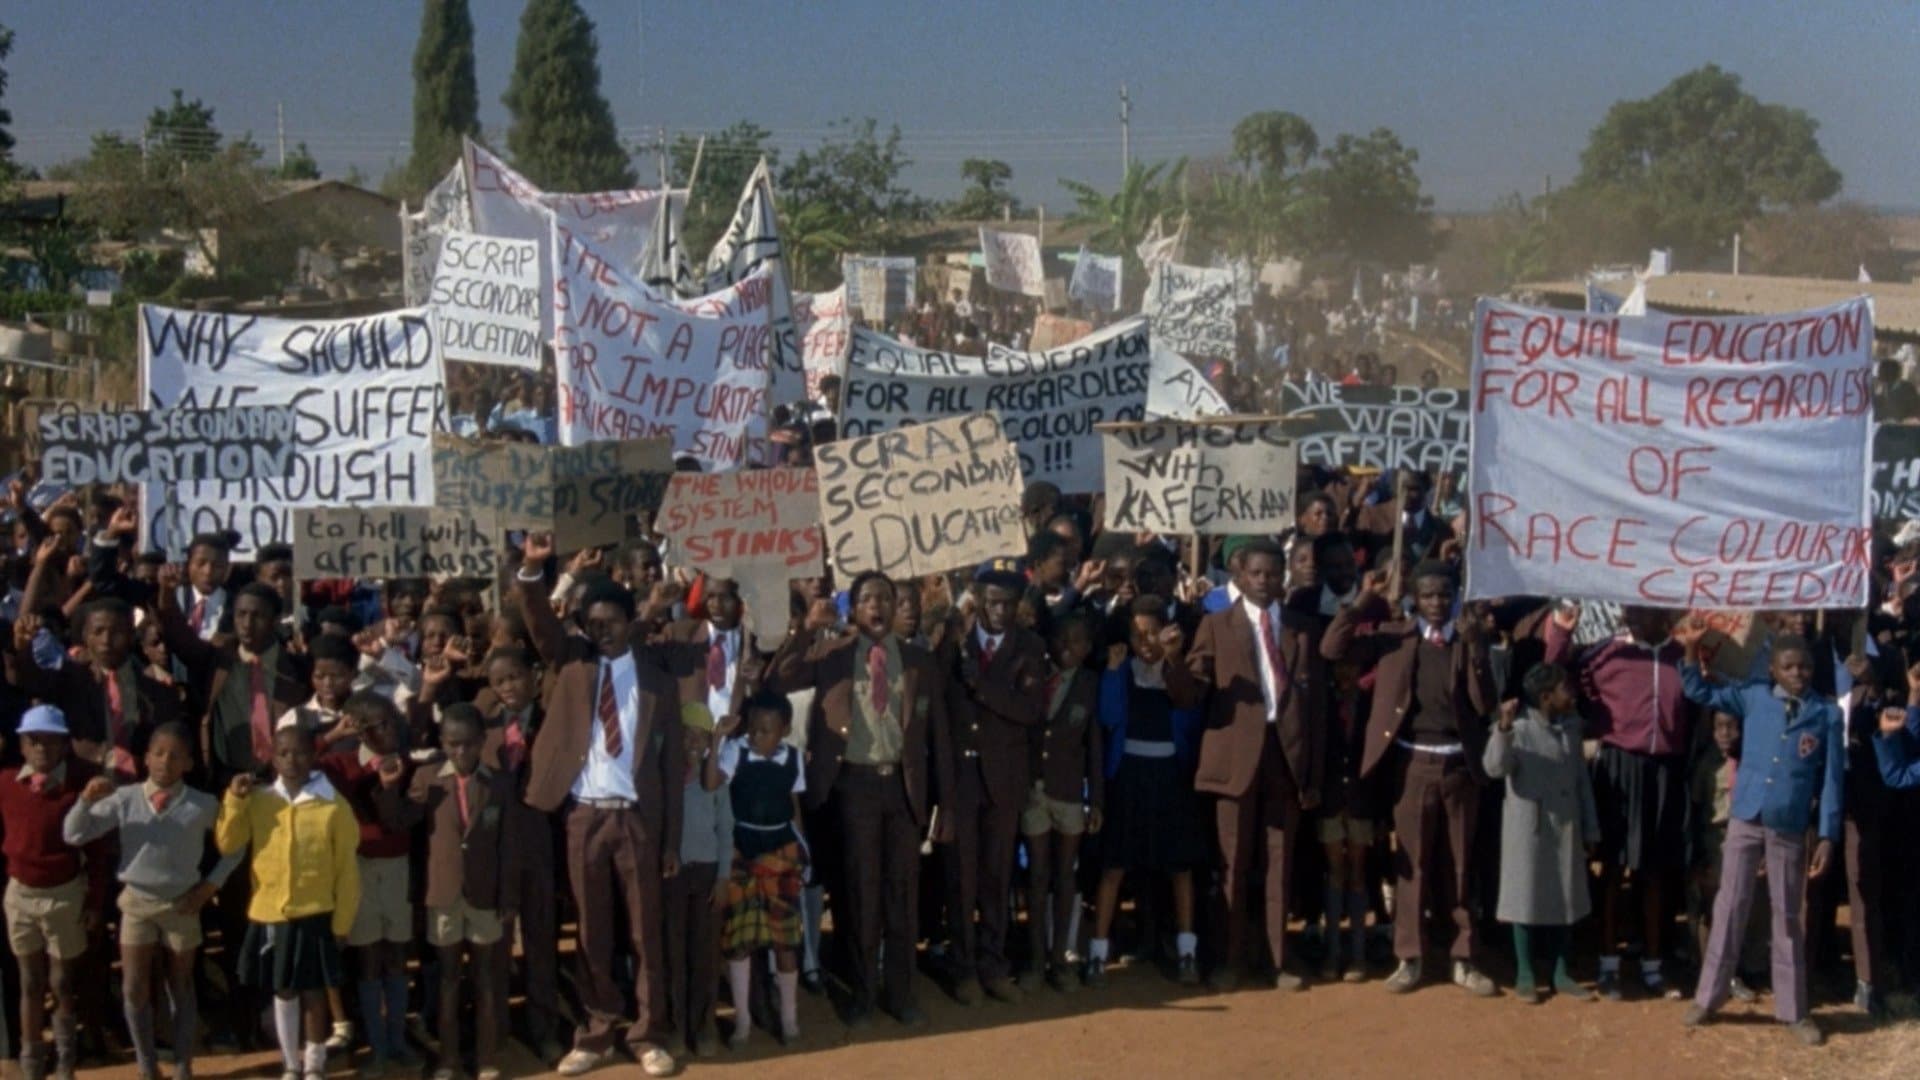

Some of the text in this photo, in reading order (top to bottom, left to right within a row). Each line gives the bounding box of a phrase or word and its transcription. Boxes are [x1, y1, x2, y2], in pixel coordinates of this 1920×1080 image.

[443, 237, 536, 278] SCRAP
[141, 304, 433, 375] WHY SHOULD
[439, 317, 543, 360] DUCATION
[578, 291, 660, 347] NOT
[664, 322, 694, 363] A
[1481, 303, 1865, 366] EQUAL EDUCATION
[849, 331, 970, 377] EQUAL
[983, 332, 1149, 377] EDUCATION
[845, 379, 911, 413] FOR
[925, 384, 972, 413] ALL
[984, 363, 1150, 413] REGARDLESS
[1282, 381, 1459, 409] WE DO
[1475, 368, 1579, 418] FOR
[1595, 376, 1664, 427] ALL
[38, 405, 297, 445] SCRAP SECONDARY
[288, 382, 448, 447] SUFFER
[1338, 406, 1469, 442] WANT
[689, 430, 766, 464] STINS
[817, 412, 1000, 481] SCRAP
[1299, 433, 1469, 472] AFRIKAA
[671, 469, 820, 500] THE WHOLE
[1627, 444, 1718, 501] OF
[306, 510, 491, 548] to hell with
[665, 498, 779, 533] SYSTEM
[1474, 491, 1872, 570] RACE COLOUR OR
[684, 526, 821, 568] STINKS
[833, 502, 1022, 578] EDUCATIO
